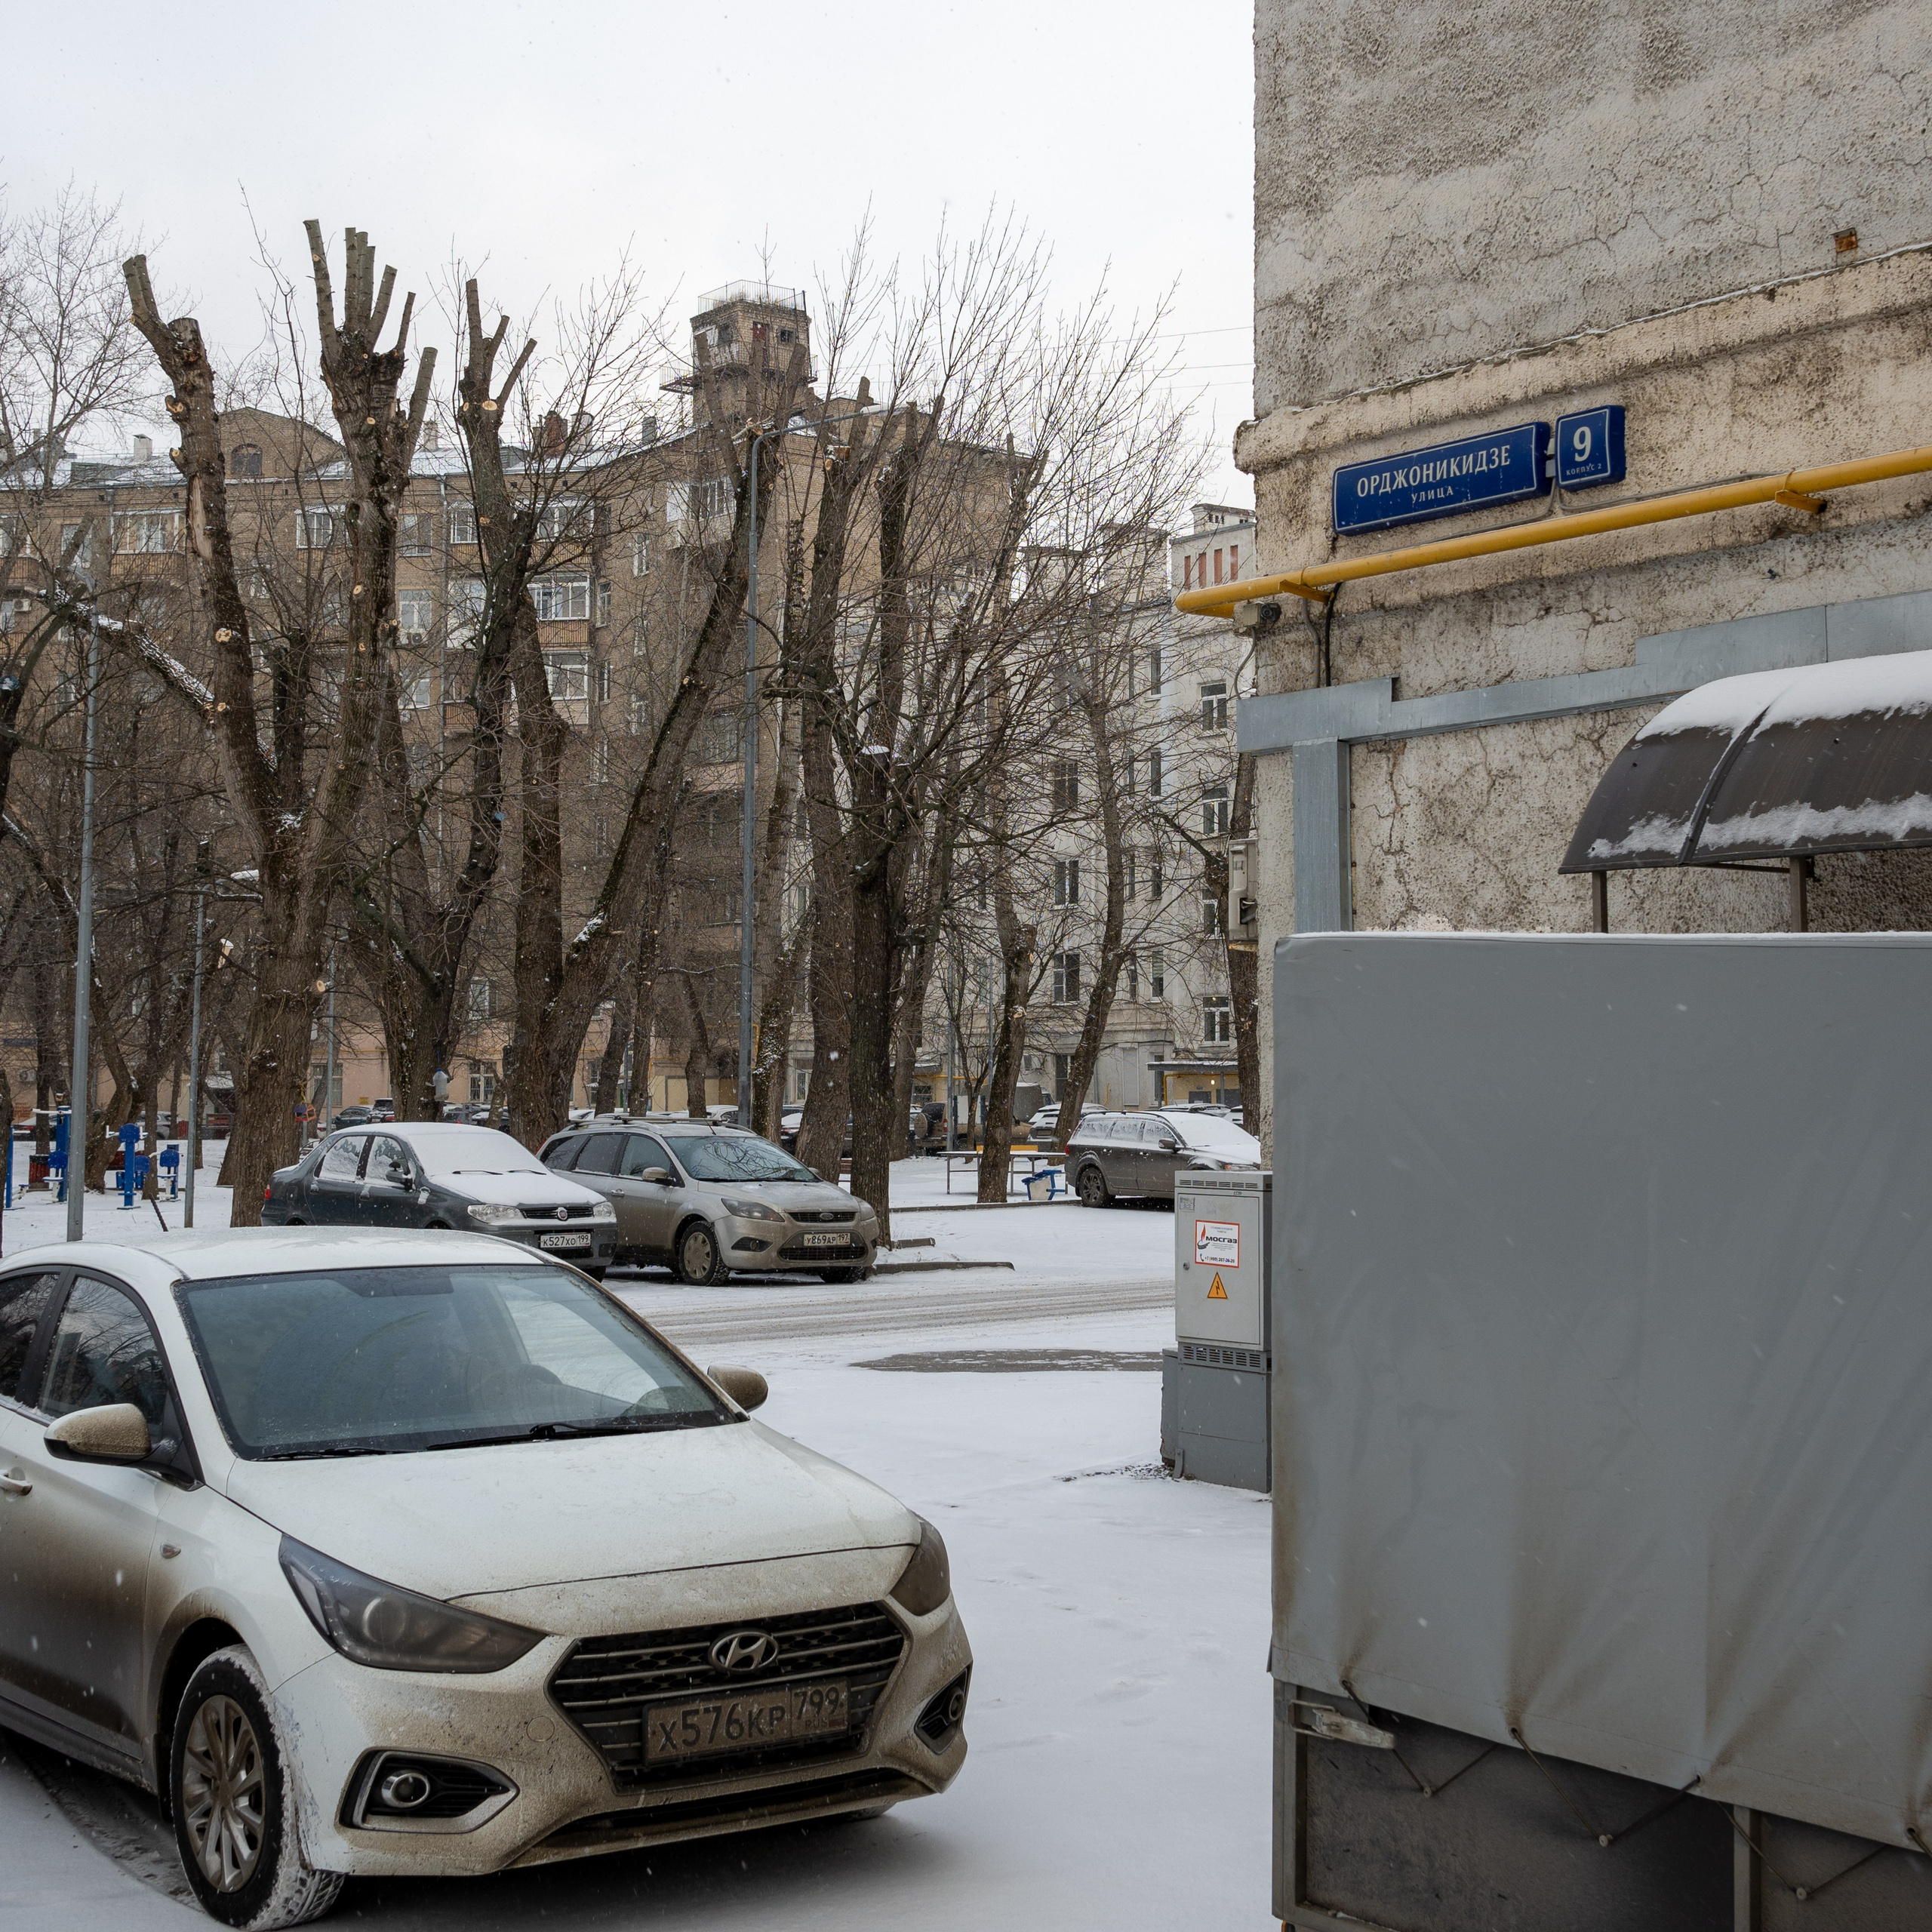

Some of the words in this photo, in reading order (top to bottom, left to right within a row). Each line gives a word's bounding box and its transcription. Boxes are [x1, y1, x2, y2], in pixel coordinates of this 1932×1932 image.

[1573, 426, 1592, 462] 9
[1357, 445, 1510, 497] ОРДЖОНИКИДЗЕ
[1566, 463, 1595, 476] КОРПУС
[1411, 485, 1454, 504] УЛИЦА
[543, 1236, 576, 1246] К527ХО
[658, 1703, 786, 1752] Х576КР
[793, 1686, 841, 1721] 799
[804, 1718, 828, 1730] RUS
